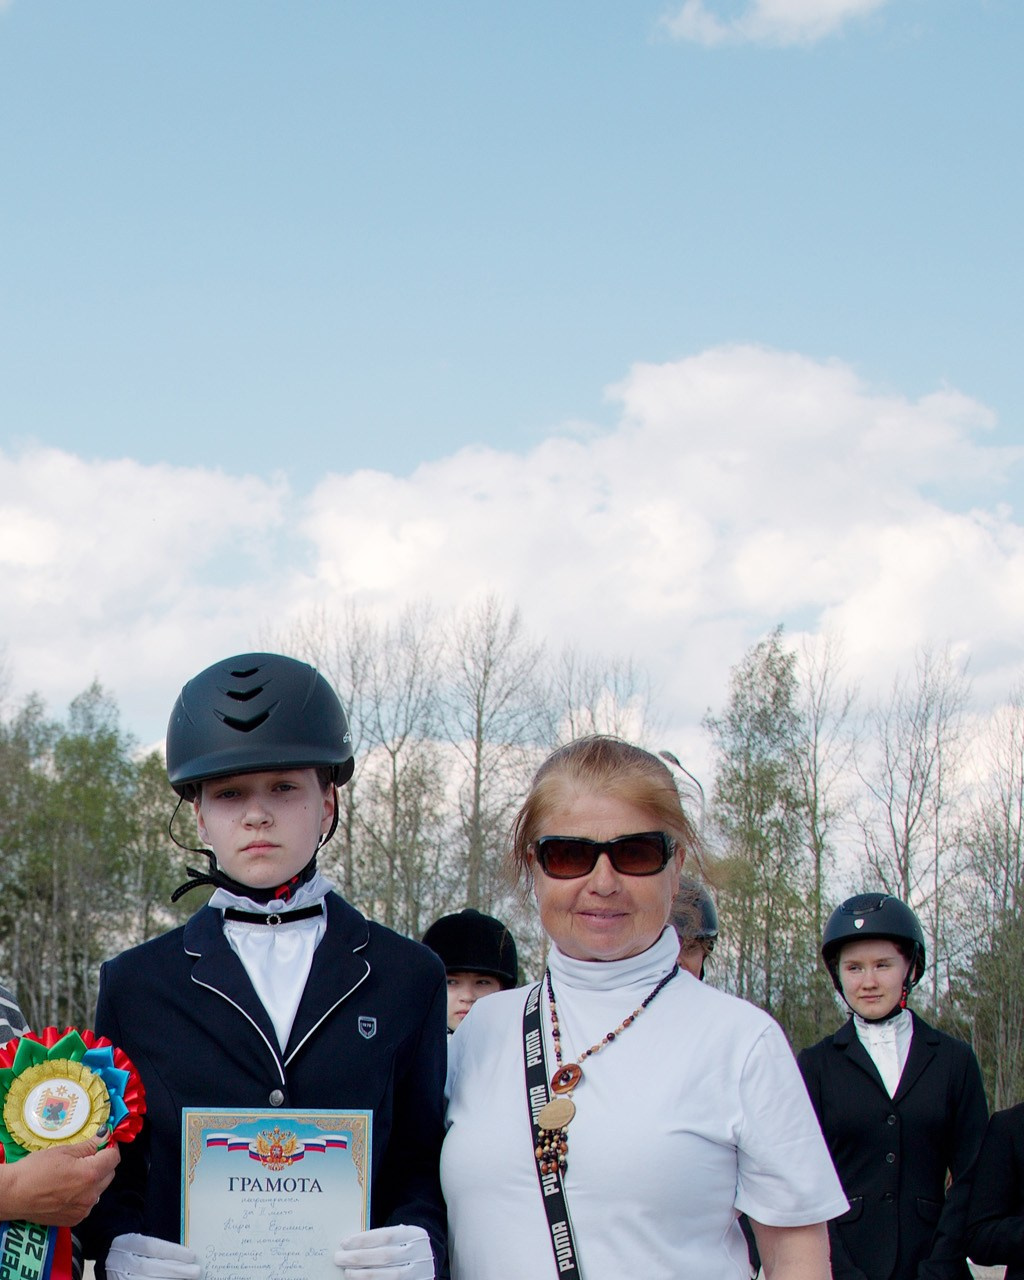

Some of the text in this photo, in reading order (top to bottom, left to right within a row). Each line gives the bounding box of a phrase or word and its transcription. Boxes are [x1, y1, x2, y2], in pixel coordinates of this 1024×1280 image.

[525, 1028, 542, 1069] PUMA
[228, 1177, 323, 1193] ГРАМОТА
[25, 1222, 48, 1262] 20
[551, 1220, 575, 1272] PUMA
